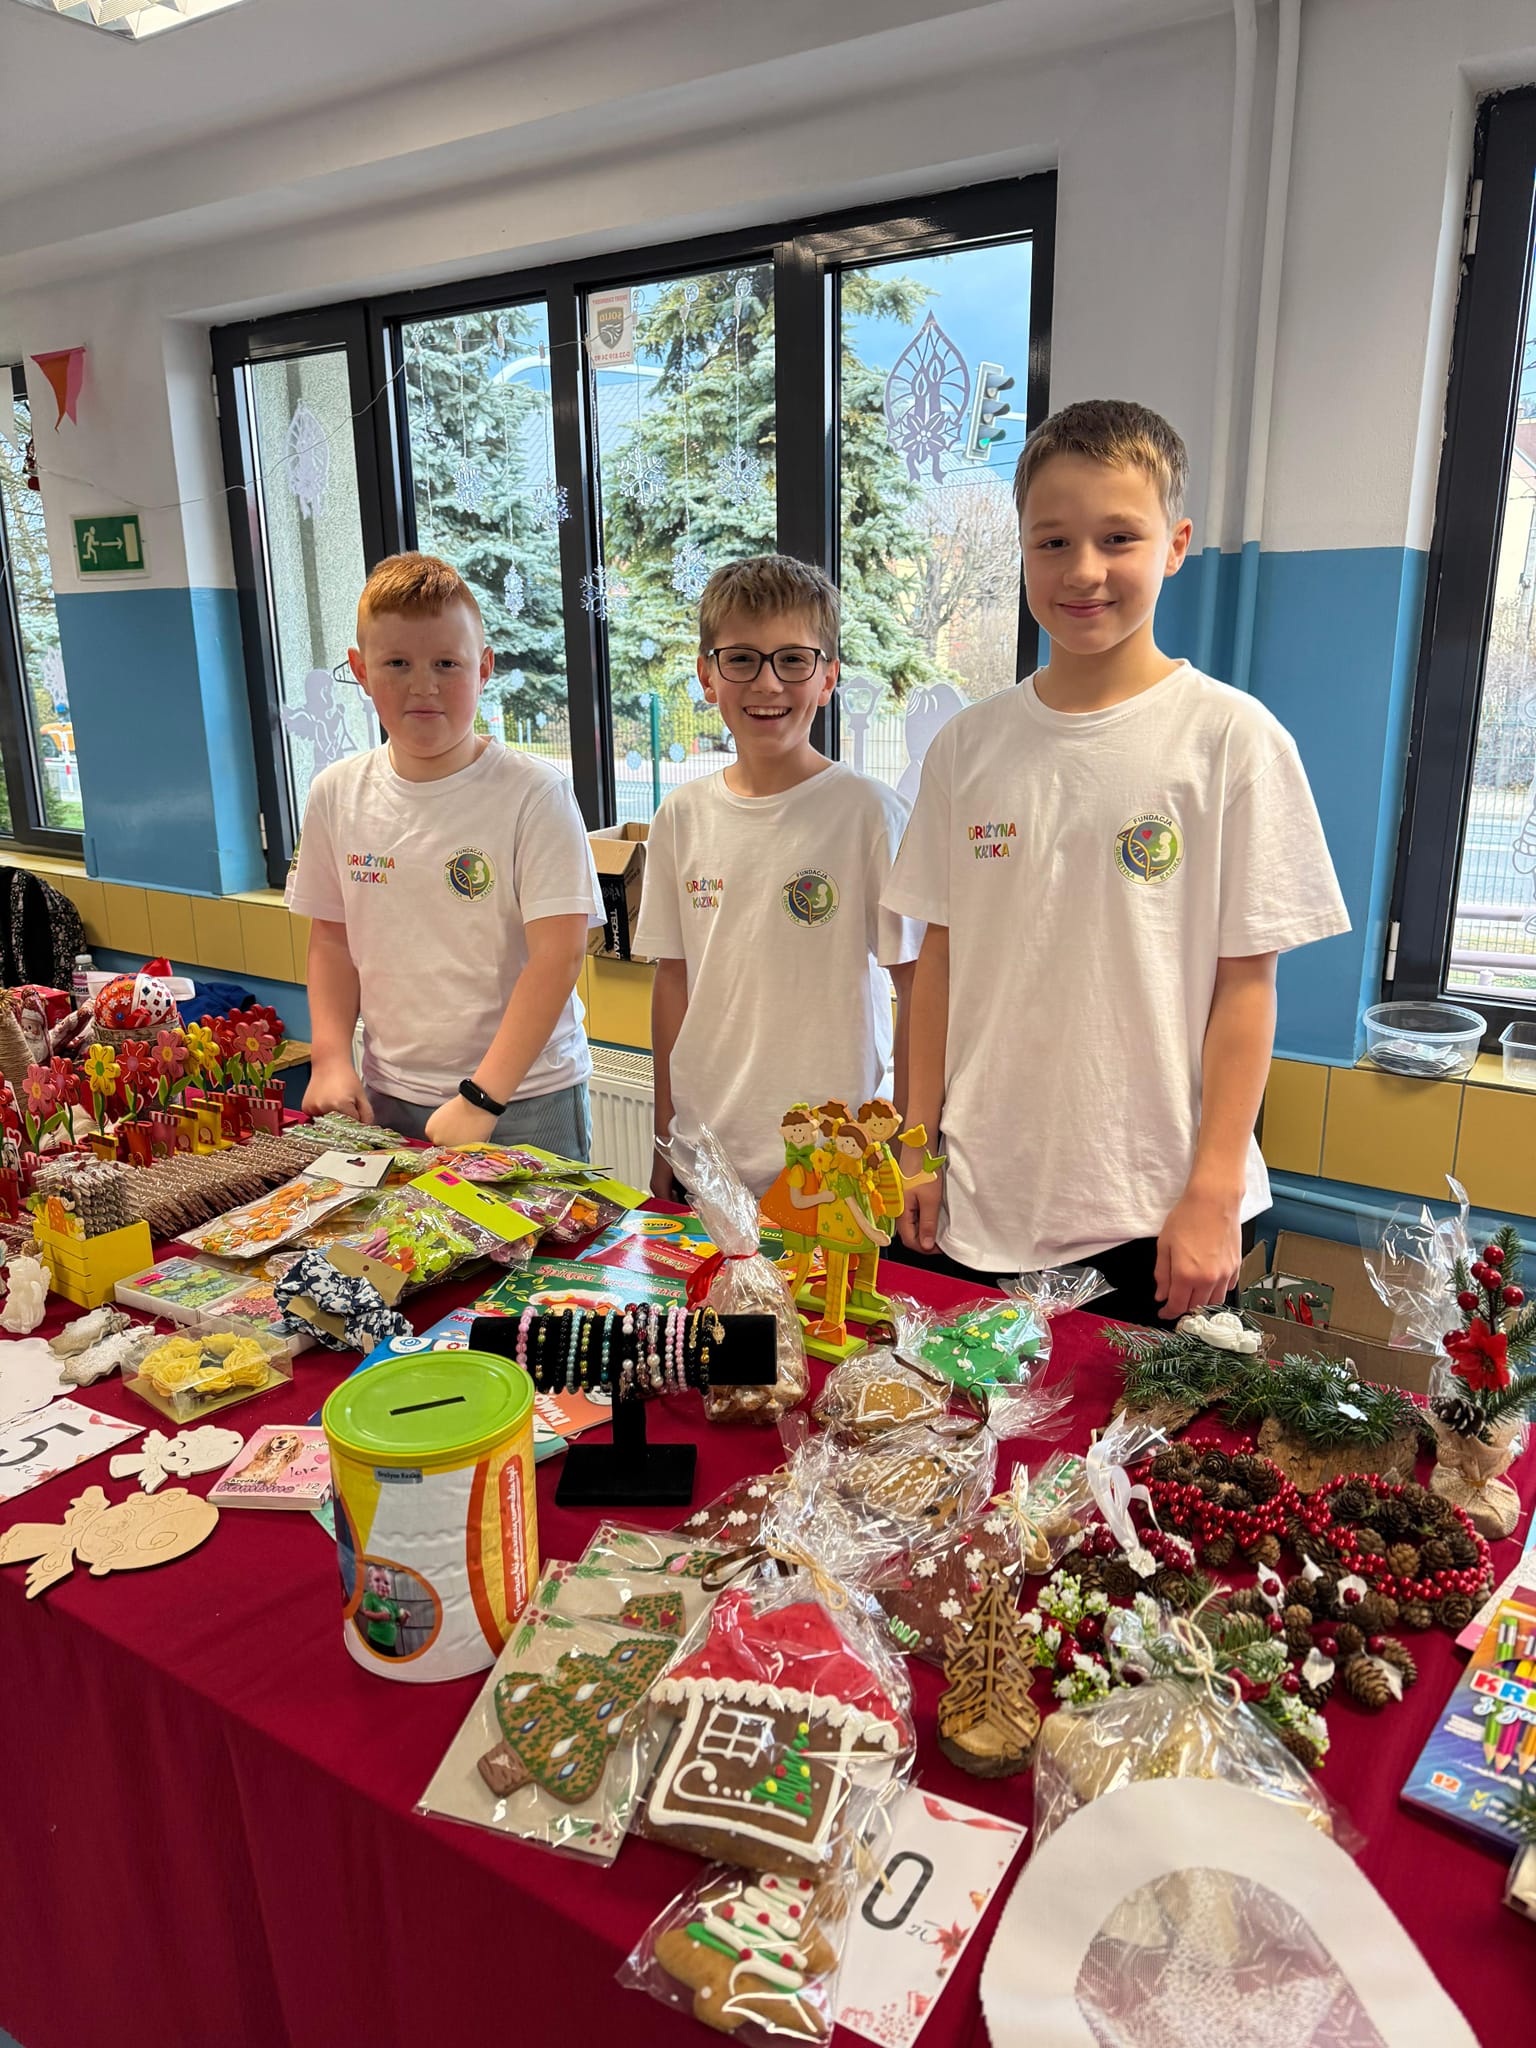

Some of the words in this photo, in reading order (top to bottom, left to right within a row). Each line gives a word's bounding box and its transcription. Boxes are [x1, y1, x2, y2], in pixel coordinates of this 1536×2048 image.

[1133, 814, 1173, 827] FUNDACJA
[347, 853, 395, 869] DRUŻYNA
[351, 870, 388, 884] KAZIKA
[290, 1466, 319, 1478] love
[1431, 1771, 1460, 1793] 12
